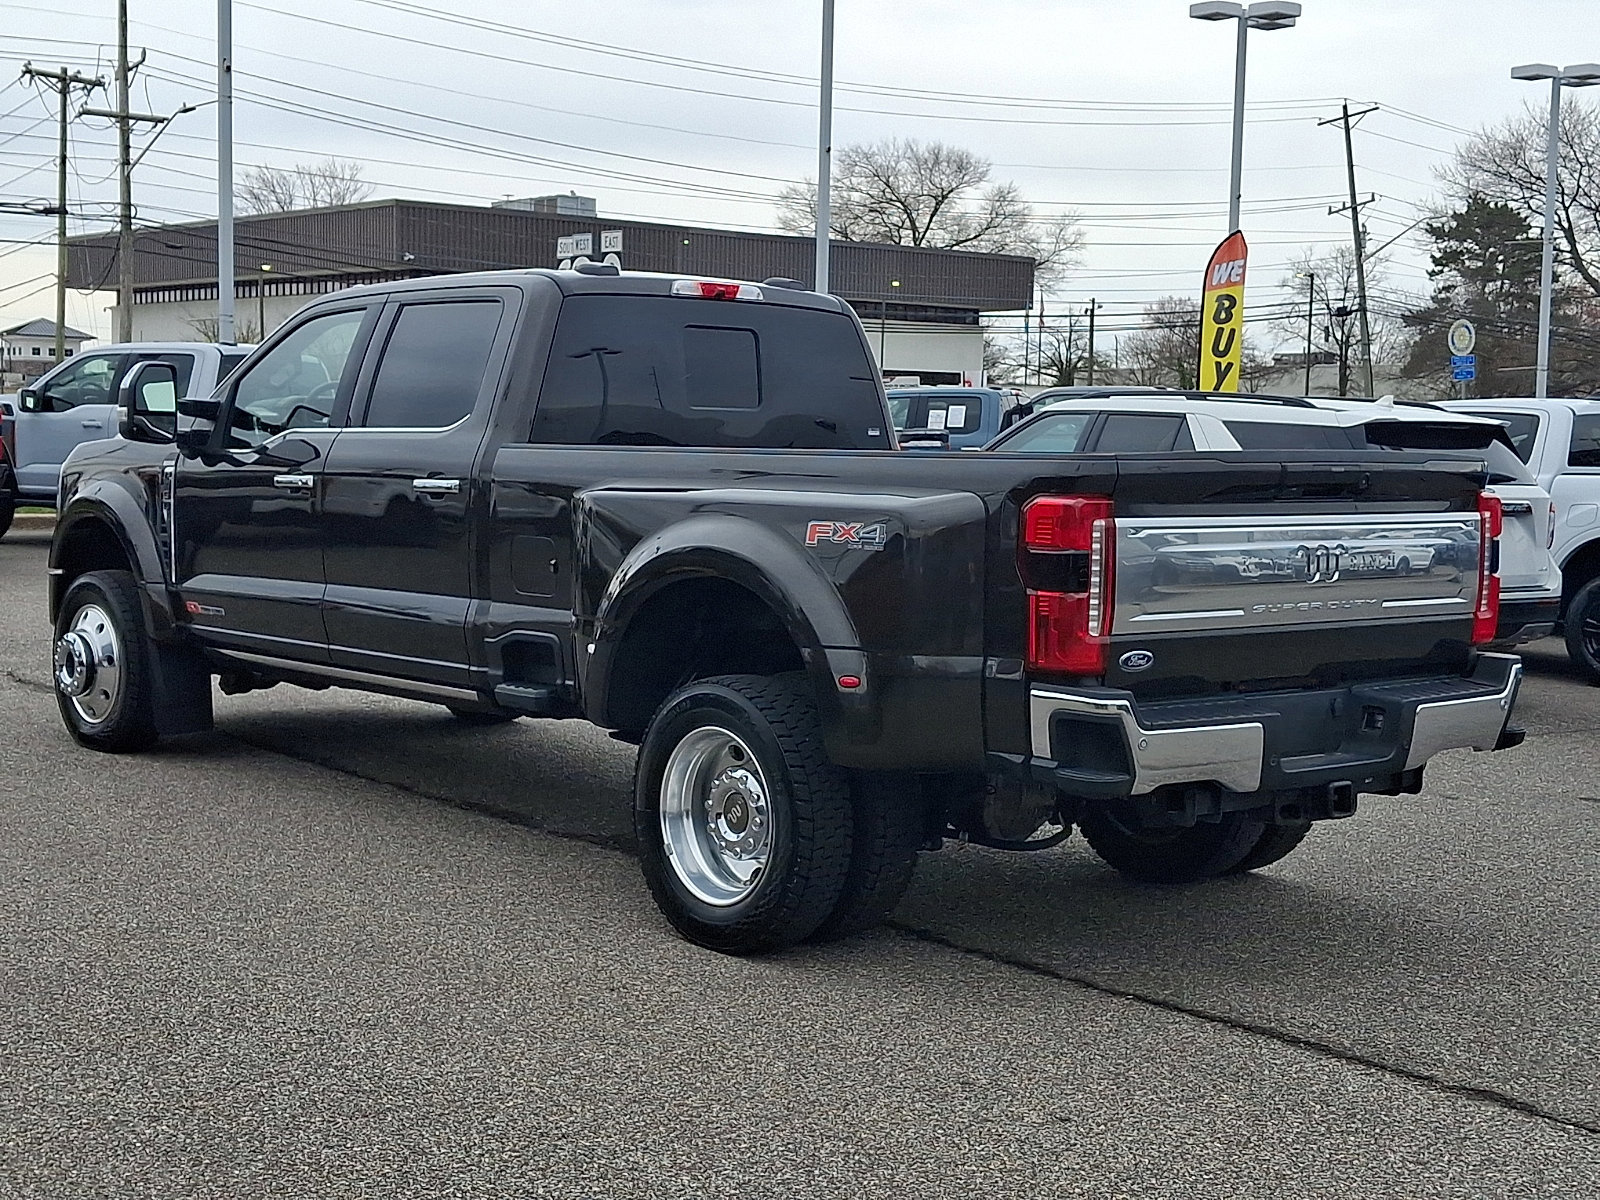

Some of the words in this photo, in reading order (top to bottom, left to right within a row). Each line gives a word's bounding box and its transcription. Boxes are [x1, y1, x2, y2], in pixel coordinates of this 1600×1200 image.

[558, 241, 574, 254] SOUT
[575, 238, 590, 251] WEST
[604, 235, 619, 249] EAST
[1211, 259, 1245, 286] WE
[1211, 293, 1237, 391] BUY
[805, 520, 886, 547] FX4
[1252, 601, 1324, 613] SUPER
[1327, 598, 1378, 609] DUTY
